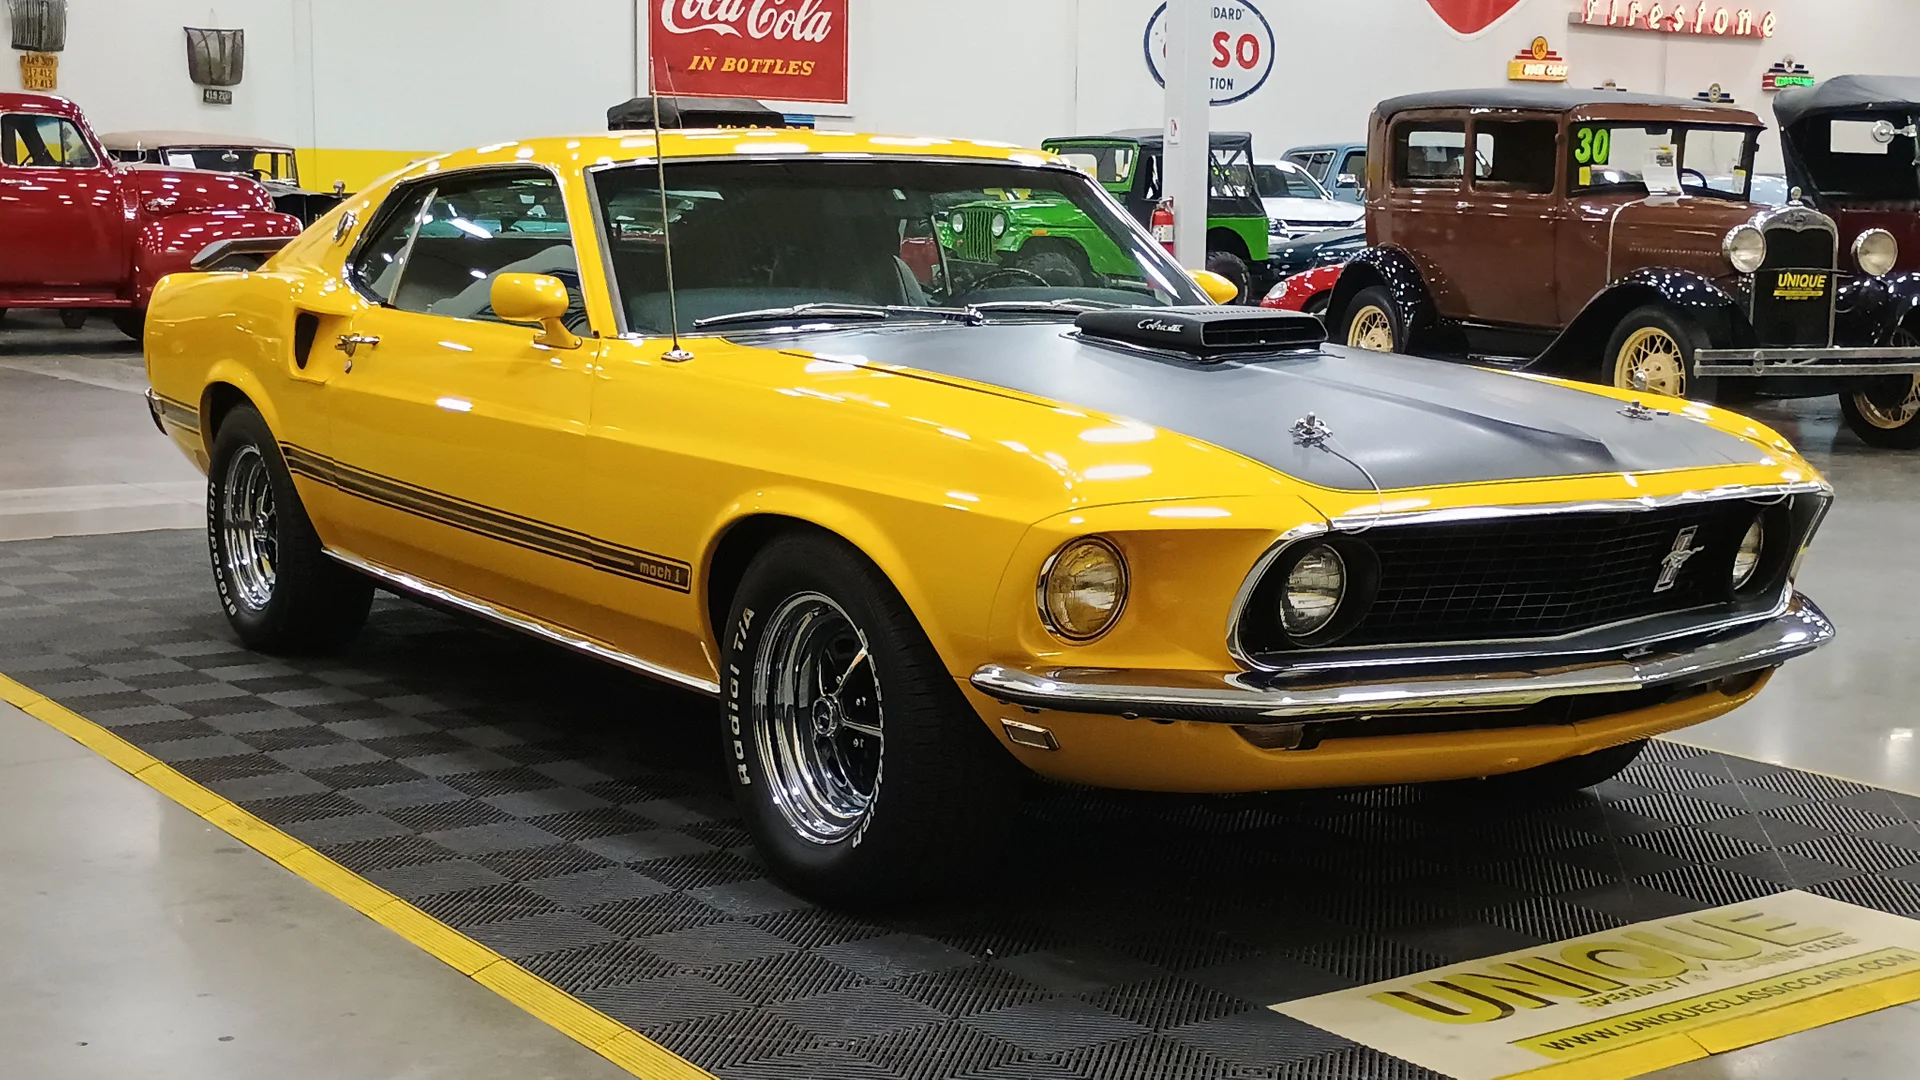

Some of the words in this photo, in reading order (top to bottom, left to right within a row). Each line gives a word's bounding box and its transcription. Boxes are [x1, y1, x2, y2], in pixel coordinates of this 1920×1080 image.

[688, 56, 717, 71] IN
[721, 57, 815, 76] BOTTLES
[1575, 127, 1608, 164] 30
[1778, 272, 1827, 288] UNIQUE
[640, 562, 671, 580] mach
[674, 568, 680, 583] 1
[733, 607, 755, 651] T/A
[728, 663, 752, 785] Radial
[1371, 911, 1844, 1024] UNIQUE
[1540, 953, 1916, 1050] WWW.UNIQUECLASSICCARS.COM
